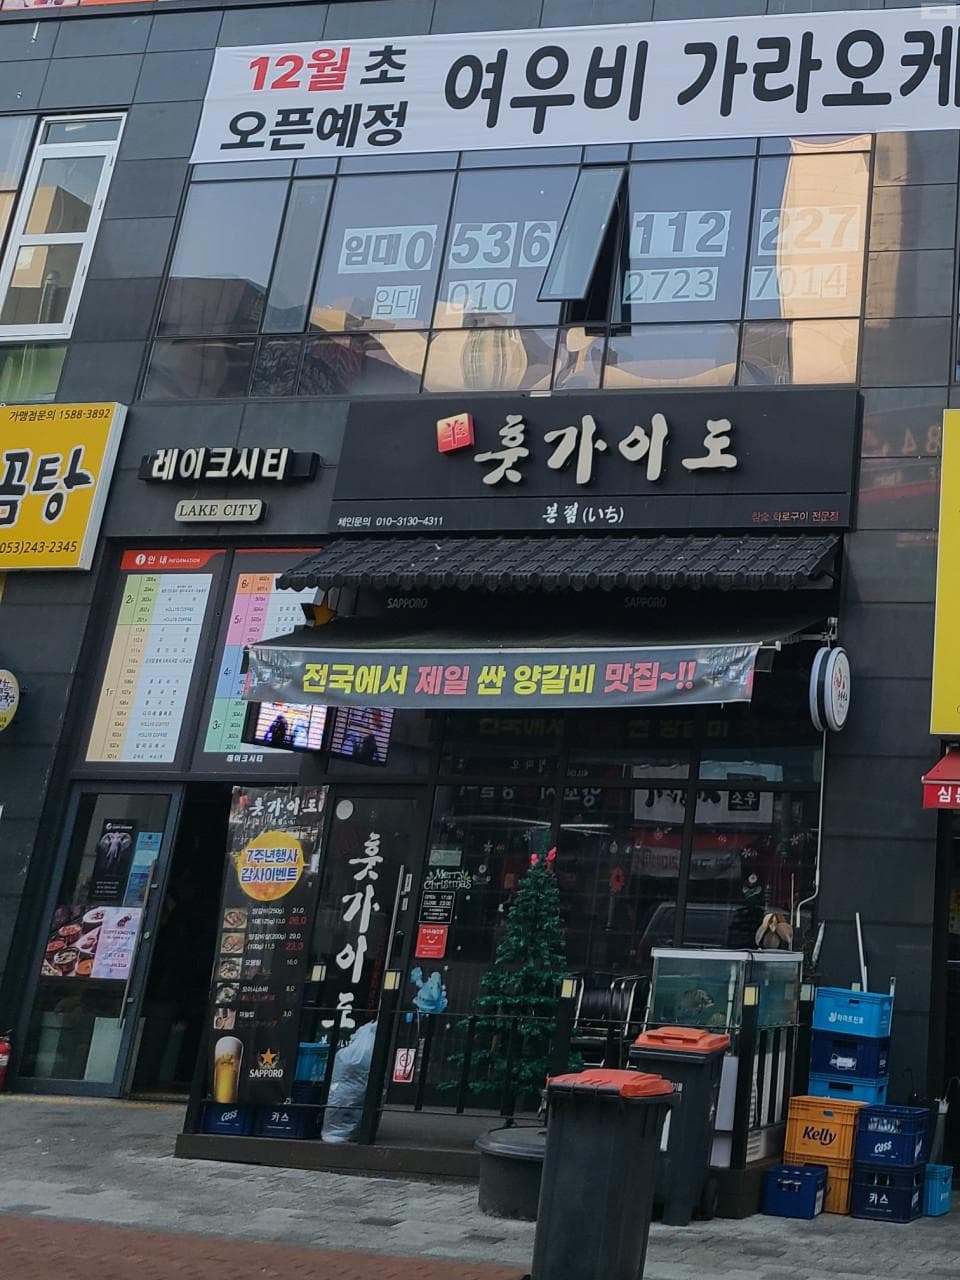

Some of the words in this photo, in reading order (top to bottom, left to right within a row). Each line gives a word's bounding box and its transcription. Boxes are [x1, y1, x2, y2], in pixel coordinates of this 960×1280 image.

[249, 47, 352, 92] 12월
[360, 44, 407, 84] 초
[444, 39, 649, 134] 여우비
[219, 101, 407, 151] 오픈예정
[375, 287, 418, 317] 임대
[624, 269, 716, 303] 2723
[9, 409, 56, 422] 가맹점문의
[59, 408, 111, 420] 1588-3892
[151, 446, 289, 481] 레이크시티
[179, 504, 218, 517] LAKE
[223, 504, 258, 517] CITY
[376, 516, 443, 527] 010-3130-4311
[303, 662, 408, 696] 전국에서
[414, 663, 469, 696] 제일
[477, 663, 507, 696] 싼
[514, 663, 596, 696] 양갈비
[604, 659, 697, 694] 맛집~!!
[247, 848, 298, 864] 7주년행사
[241, 866, 298, 882] 감사이벤트
[424, 879, 472, 890] Christmas
[249, 1069, 284, 1078] SAPPORO
[271, 1111, 289, 1122] 카스
[802, 1126, 838, 1146] Kelly
[869, 1192, 889, 1204] 카스
